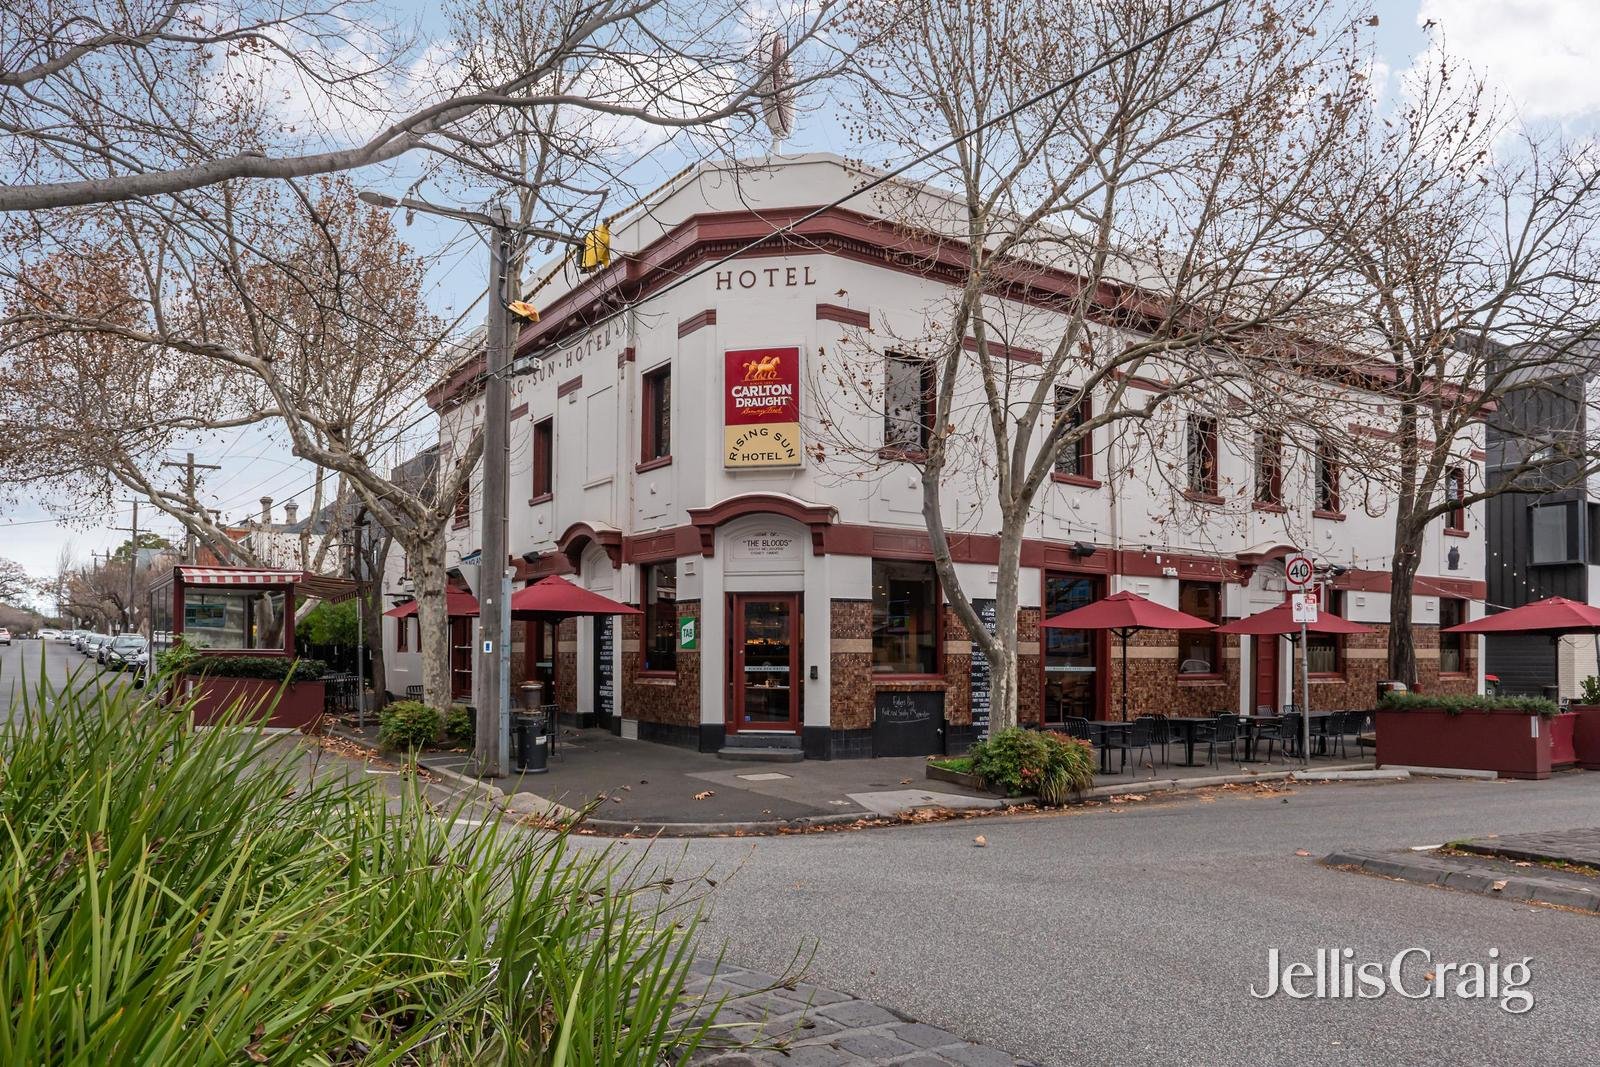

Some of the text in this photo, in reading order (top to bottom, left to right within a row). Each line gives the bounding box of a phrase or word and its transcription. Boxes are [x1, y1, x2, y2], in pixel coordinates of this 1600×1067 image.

[716, 266, 816, 290] HOTEL
[533, 330, 611, 386] SUN HOTEL
[731, 384, 793, 397] CARLTON
[735, 396, 788, 408] DRAUGHT
[729, 428, 796, 461] RISING SUN
[742, 452, 783, 461] HOTEL
[1290, 564, 1309, 578] 40
[683, 628, 693, 638] TAB
